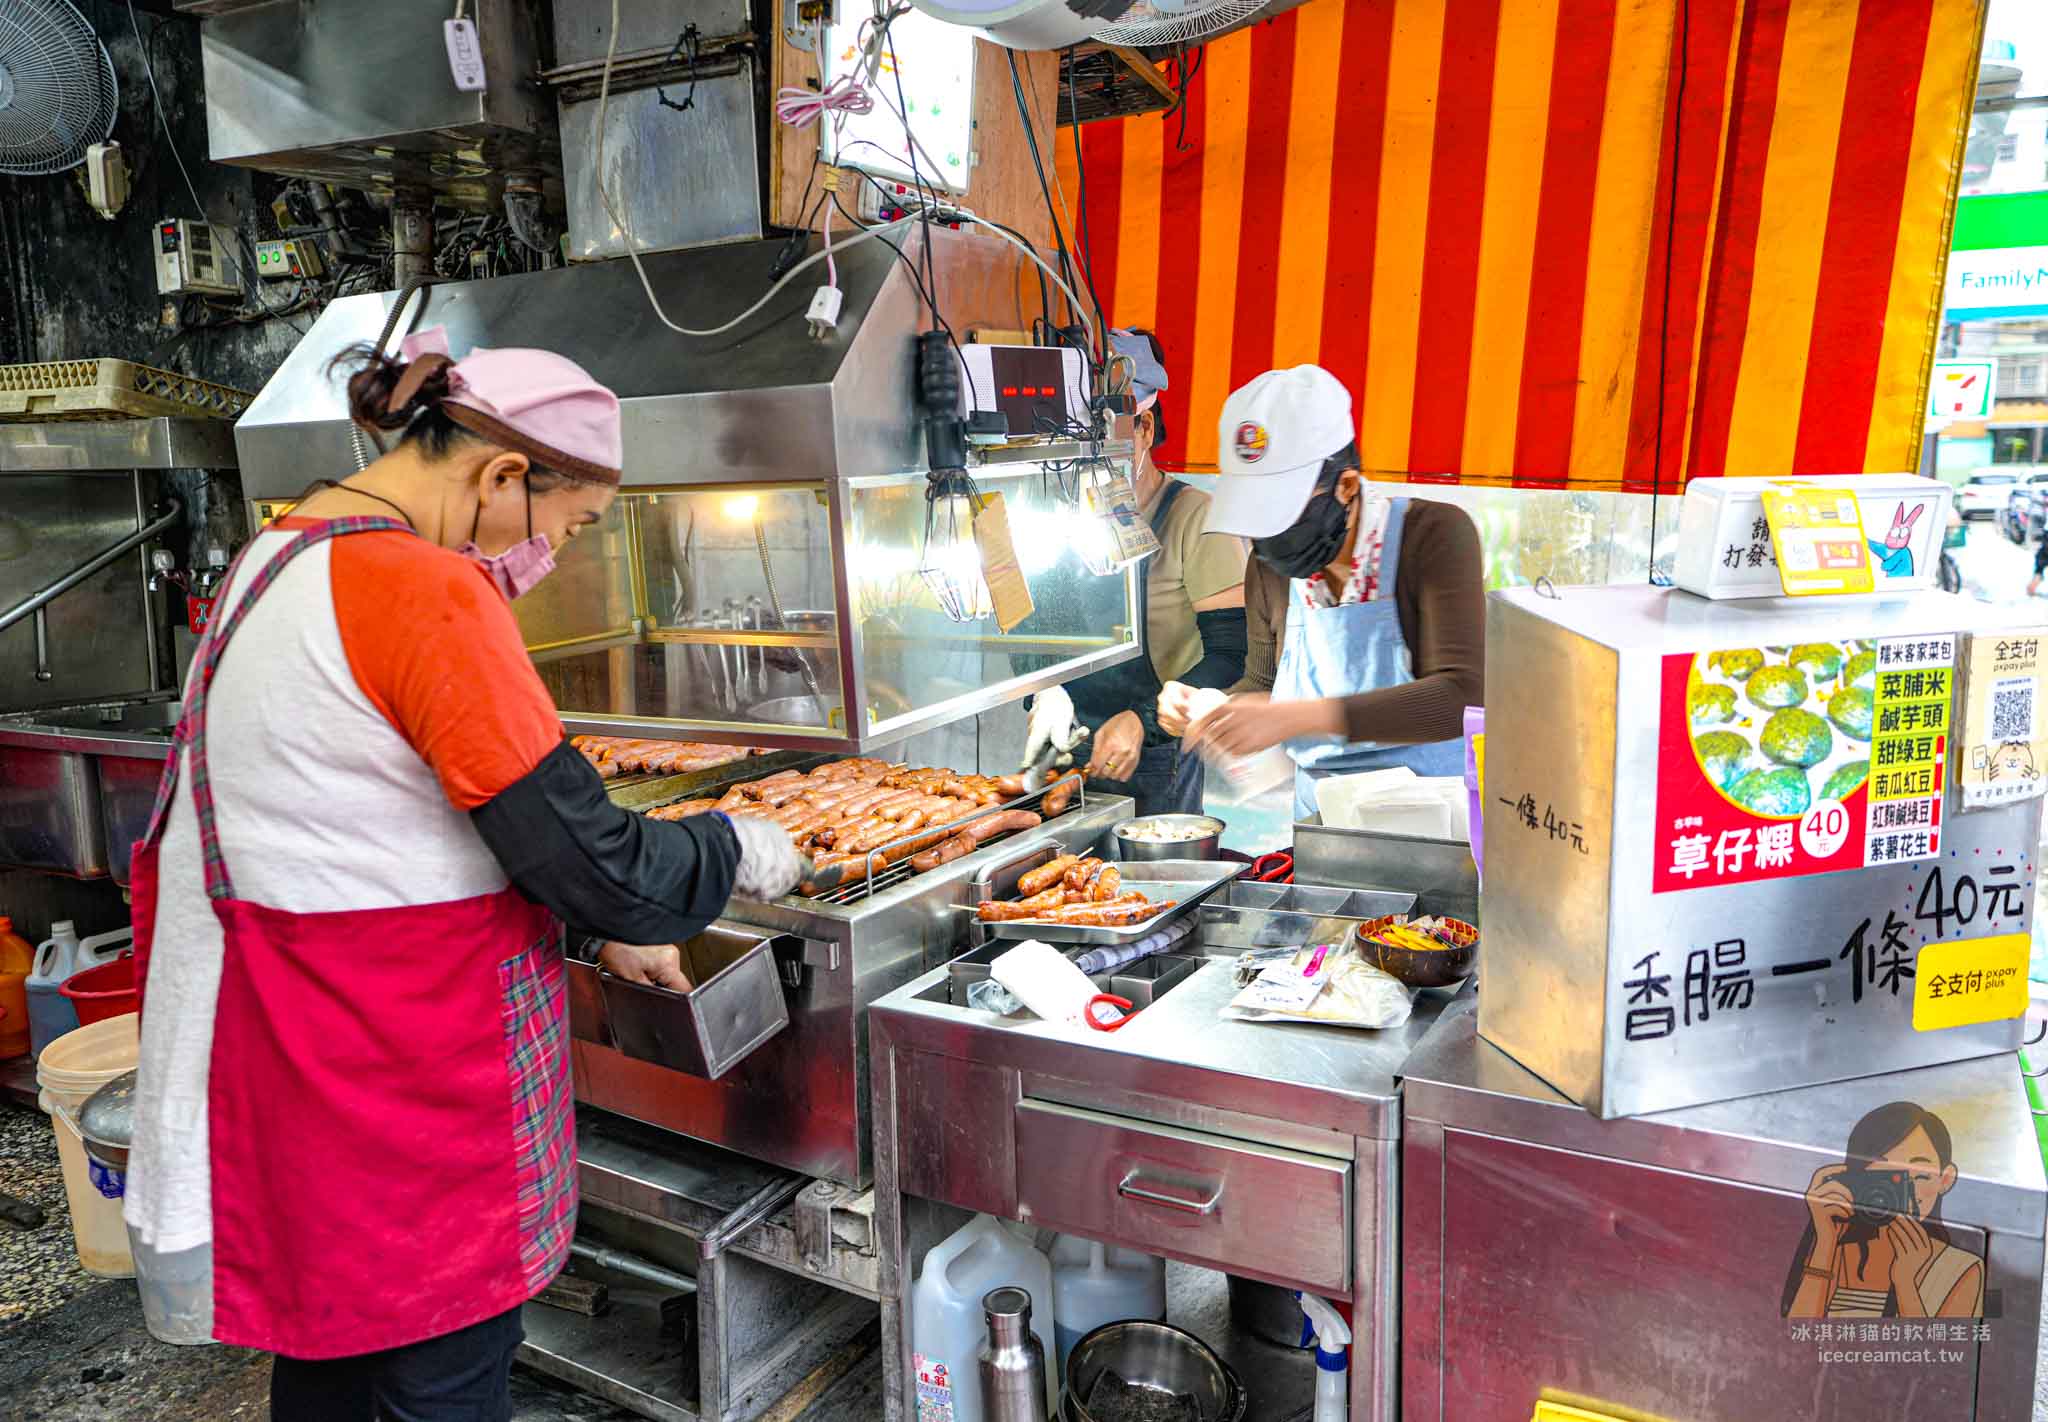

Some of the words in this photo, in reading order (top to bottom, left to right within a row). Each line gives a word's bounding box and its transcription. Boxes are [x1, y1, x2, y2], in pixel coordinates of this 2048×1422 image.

[1880, 641, 1951, 665] 糯米客家菜包
[1994, 639, 2038, 661] 全支付
[1881, 671, 1945, 699] 菜脯米
[1880, 703, 1943, 732] 鹹芋頭
[1877, 736, 1933, 765] 甜綠豆
[1875, 769, 1931, 800] 南瓜紅豆
[1806, 808, 1842, 837] 40
[1668, 823, 1795, 879] 草仔粿
[1870, 832, 1928, 862] 紫薯花生
[1928, 969, 1983, 999] 全支付
[1985, 967, 2018, 981] pxpay
[1985, 980, 2006, 991] plus
